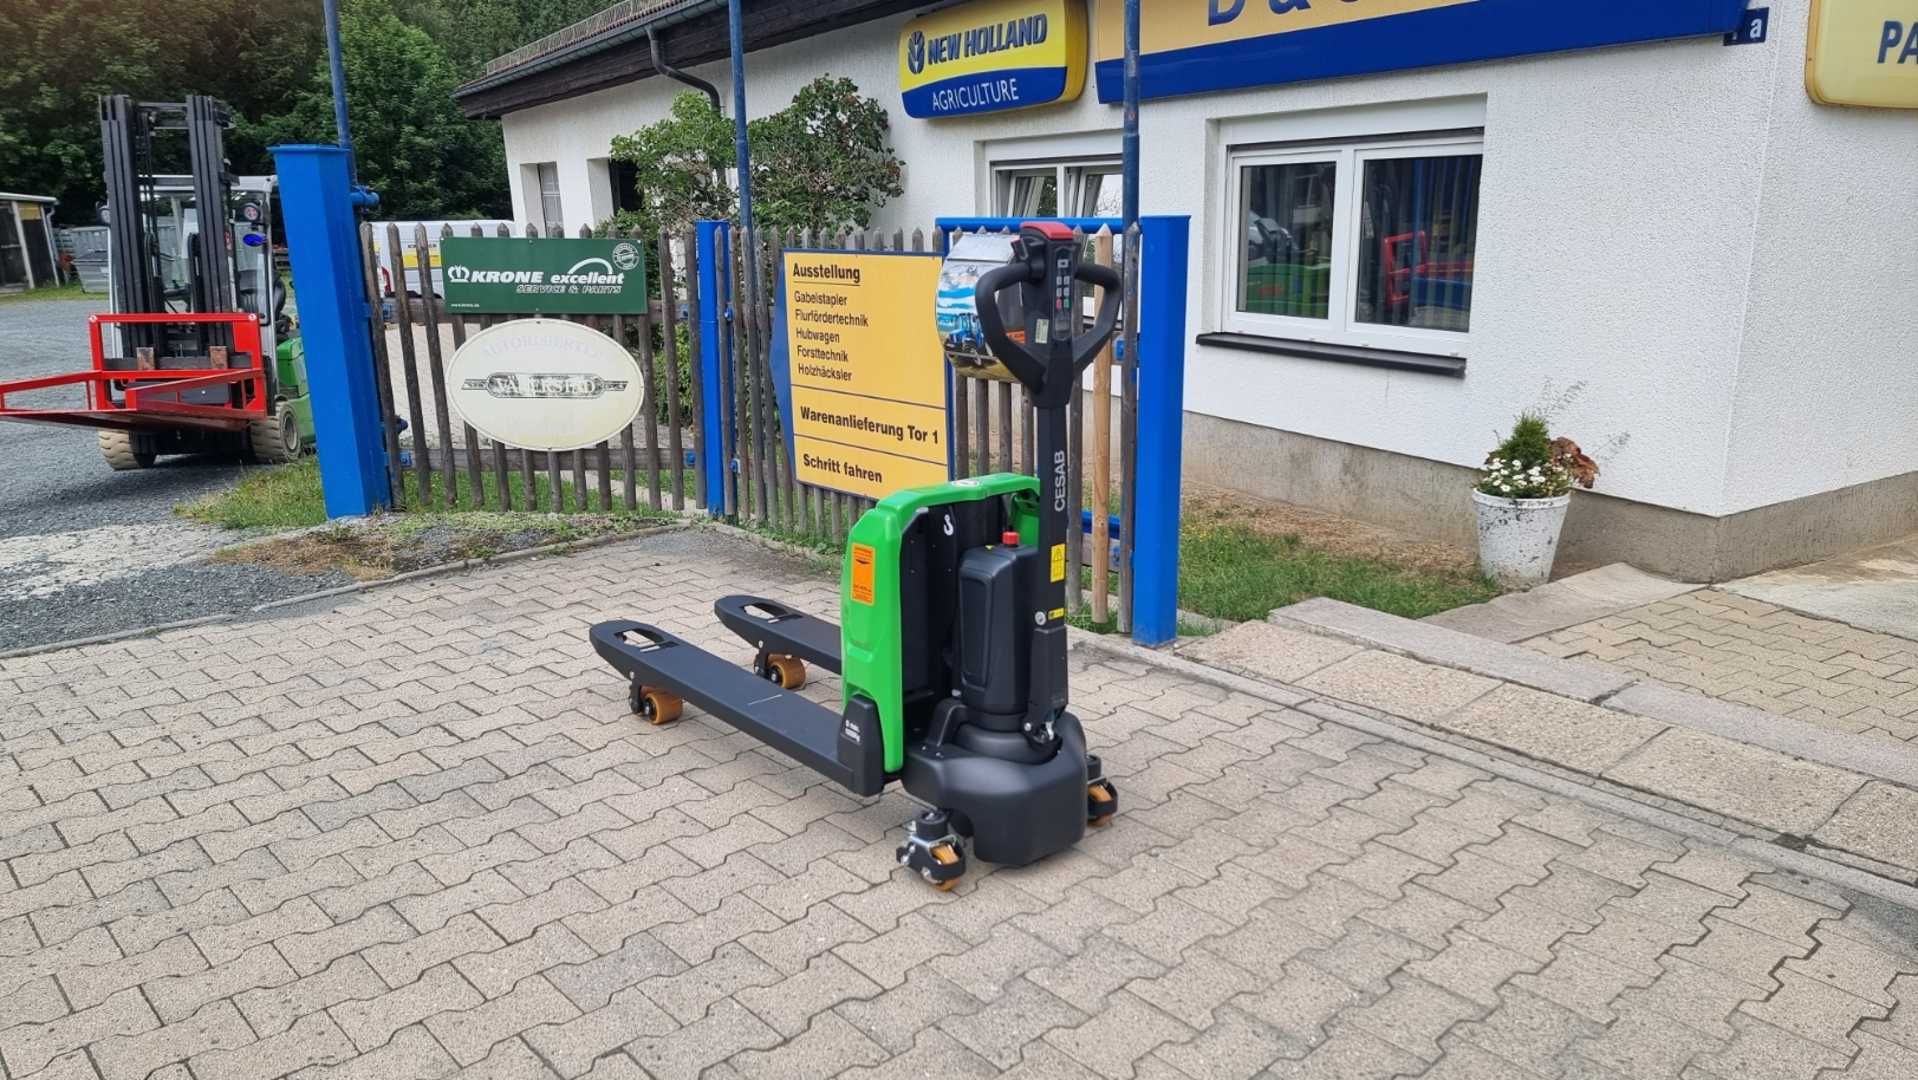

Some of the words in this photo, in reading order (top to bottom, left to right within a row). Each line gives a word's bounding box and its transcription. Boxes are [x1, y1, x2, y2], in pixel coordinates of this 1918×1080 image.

[927, 32, 962, 65] NEW
[963, 13, 1048, 58] HOLLAND
[932, 78, 1019, 111] AGRICULTURE
[471, 271, 544, 283] KRONE
[550, 271, 625, 285] excellent
[792, 262, 861, 284] Ausstellung
[794, 290, 848, 308] Gabelstapler
[795, 309, 869, 327] Flurfördertechnik
[796, 328, 840, 345] Hubwagen
[797, 345, 849, 362] Forsttechnik
[798, 363, 852, 381] Holzhäcksler
[800, 406, 904, 441] Warenanlieferung
[907, 425, 928, 442] Tor
[932, 430, 938, 444] 1
[803, 453, 841, 474] Schritt
[844, 461, 883, 483] fahren
[1054, 450, 1066, 512] CESAB
